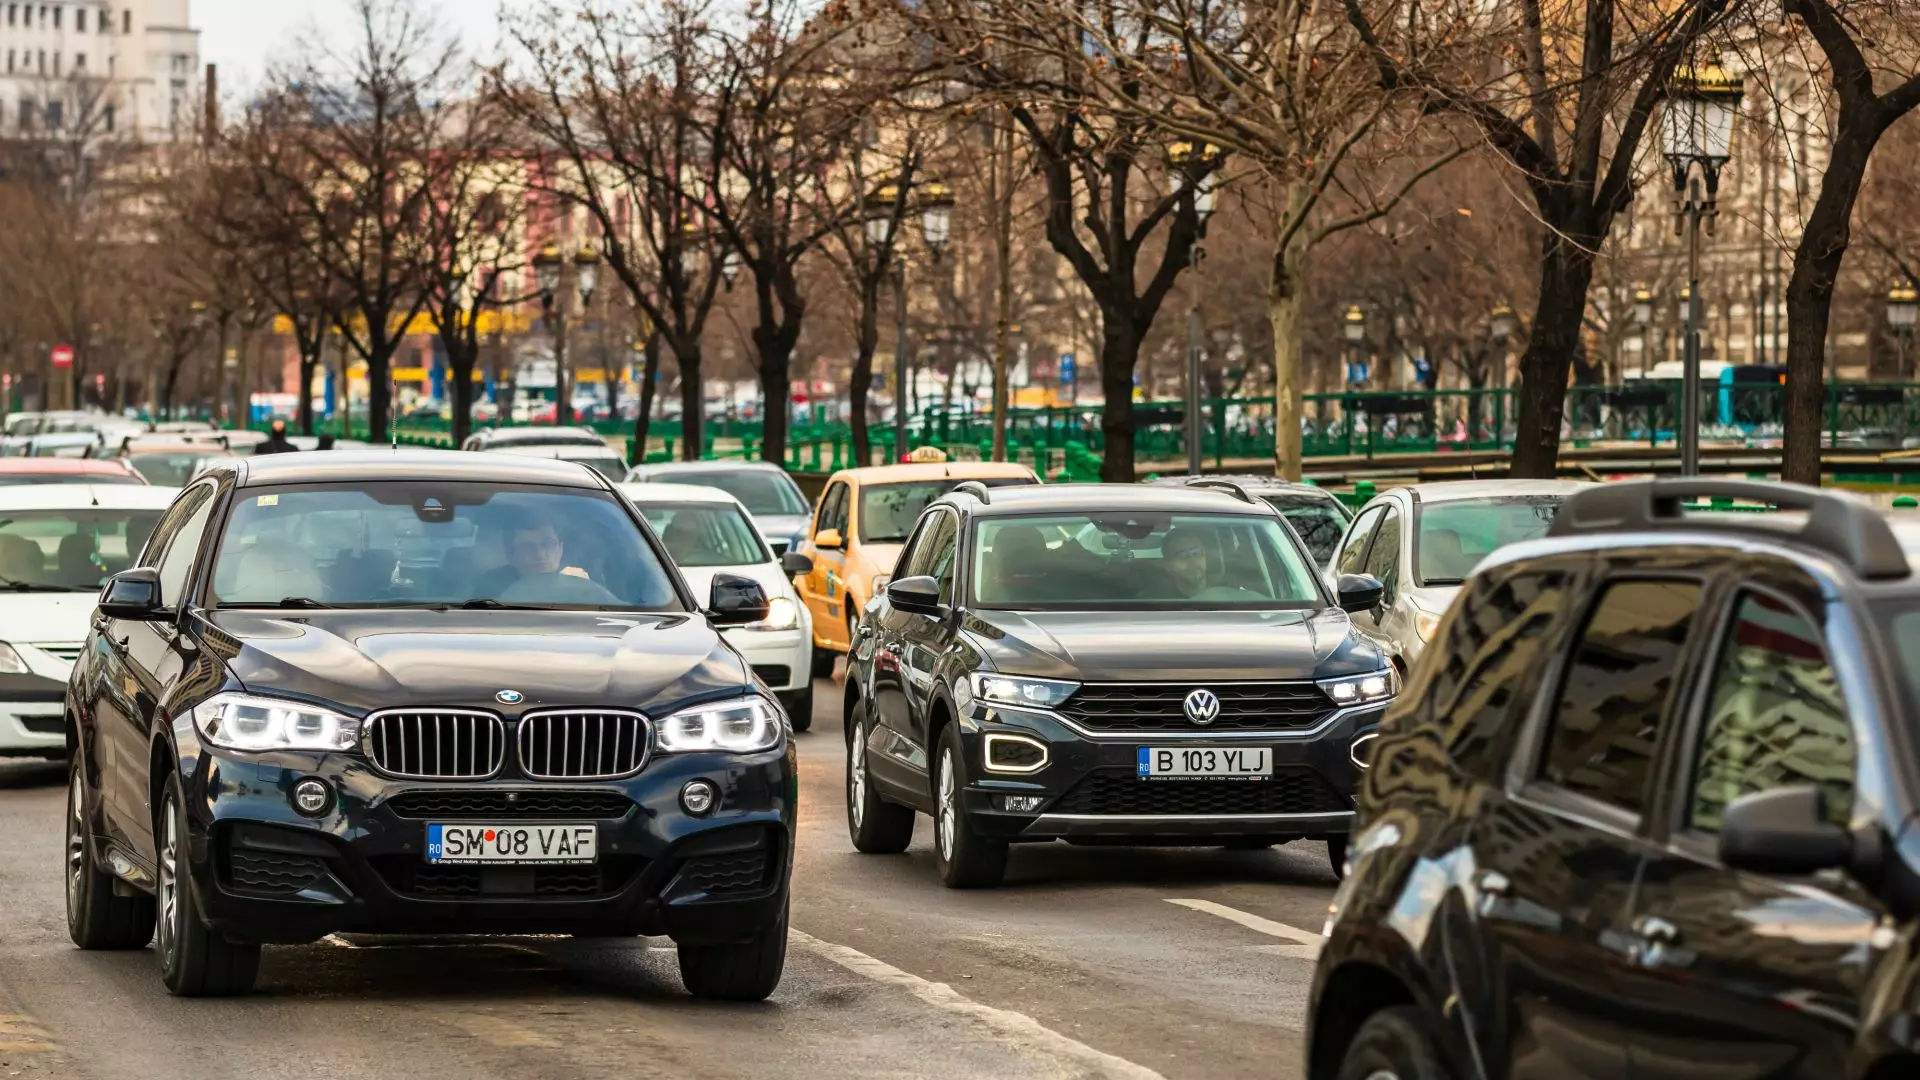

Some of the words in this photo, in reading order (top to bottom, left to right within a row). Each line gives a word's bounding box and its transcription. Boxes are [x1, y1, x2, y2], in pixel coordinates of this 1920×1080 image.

[918, 448, 940, 459] TAXI
[1157, 750, 1173, 772] B
[1182, 750, 1216, 772] 103
[1222, 750, 1264, 772] YLJ
[1139, 763, 1149, 772] RO
[445, 828, 484, 855] SM
[495, 828, 529, 855] 08
[537, 828, 593, 855] VAF
[429, 843, 441, 854] RO
